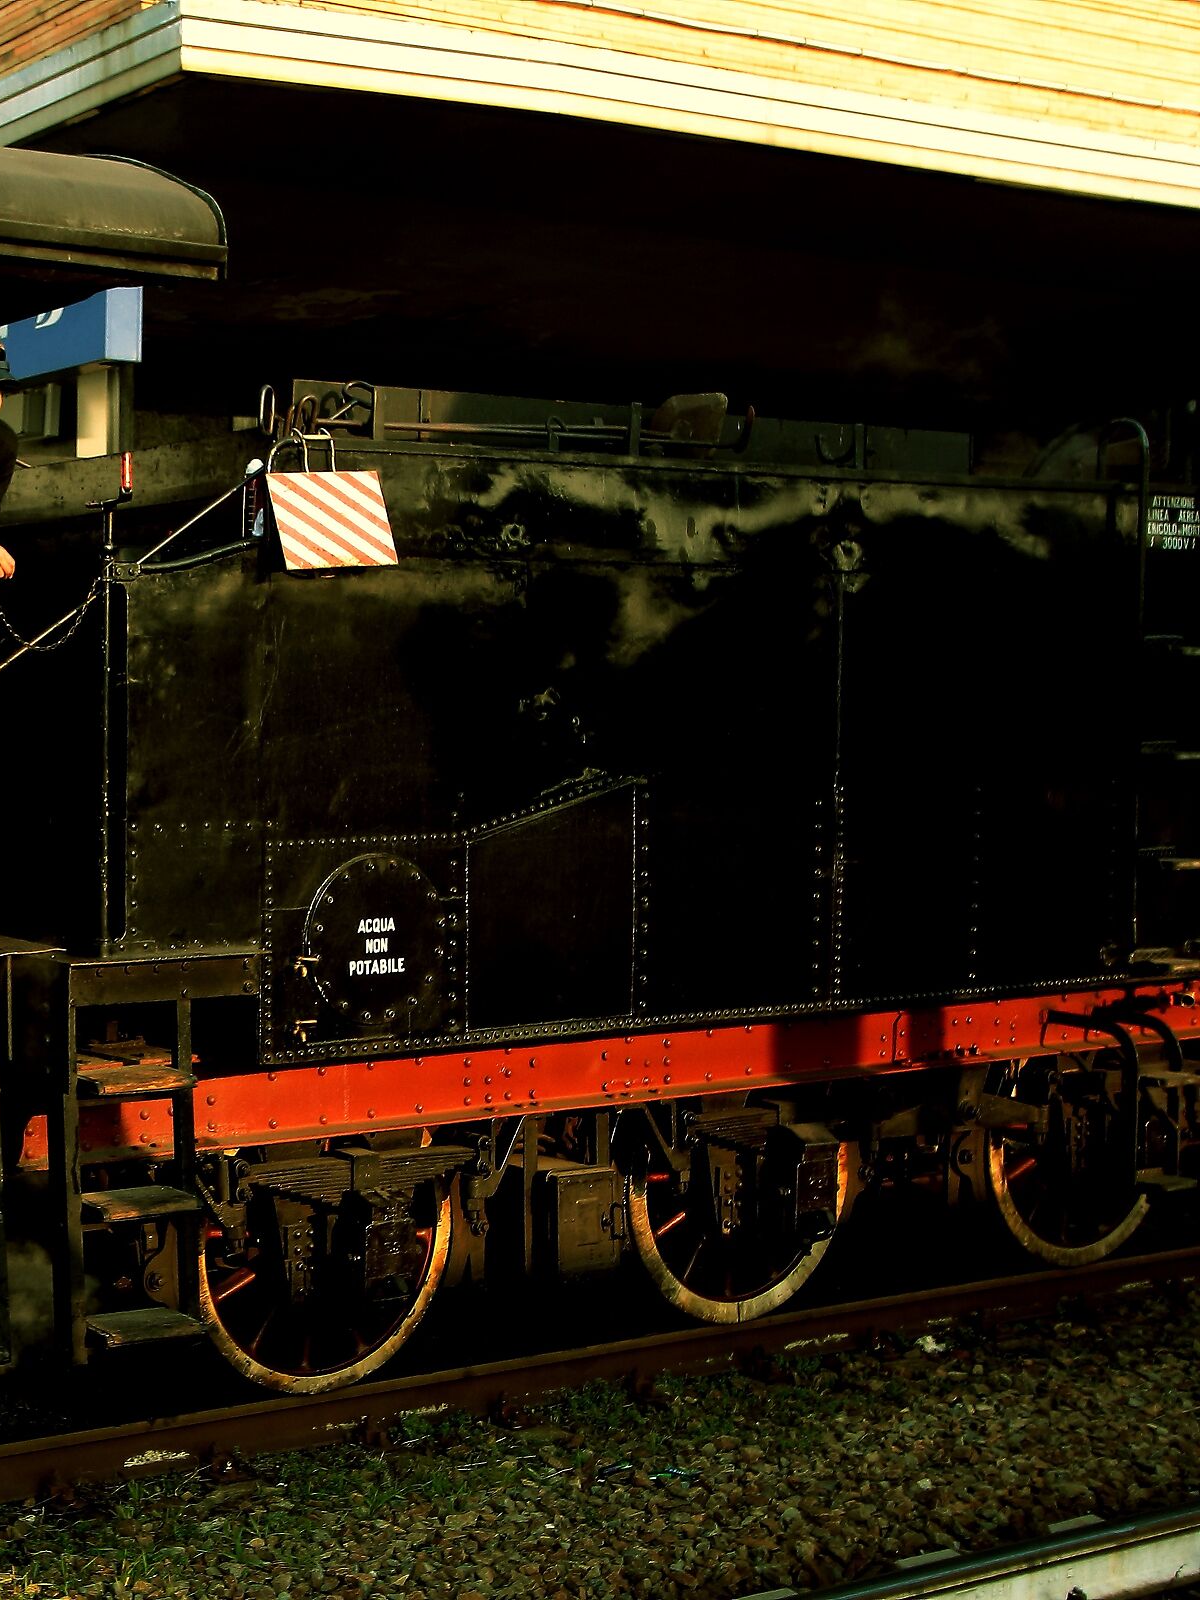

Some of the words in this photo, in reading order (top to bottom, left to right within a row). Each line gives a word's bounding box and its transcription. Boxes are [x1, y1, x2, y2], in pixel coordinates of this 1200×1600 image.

[1152, 496, 1195, 508] ATTENZIONE
[1147, 508, 1169, 521] LINEA
[1178, 509, 1200, 522] AEREA
[1147, 522, 1178, 536] ERICOLO
[357, 917, 396, 934] ACQUA
[365, 937, 389, 954] NON
[349, 957, 406, 977] POTABILE
